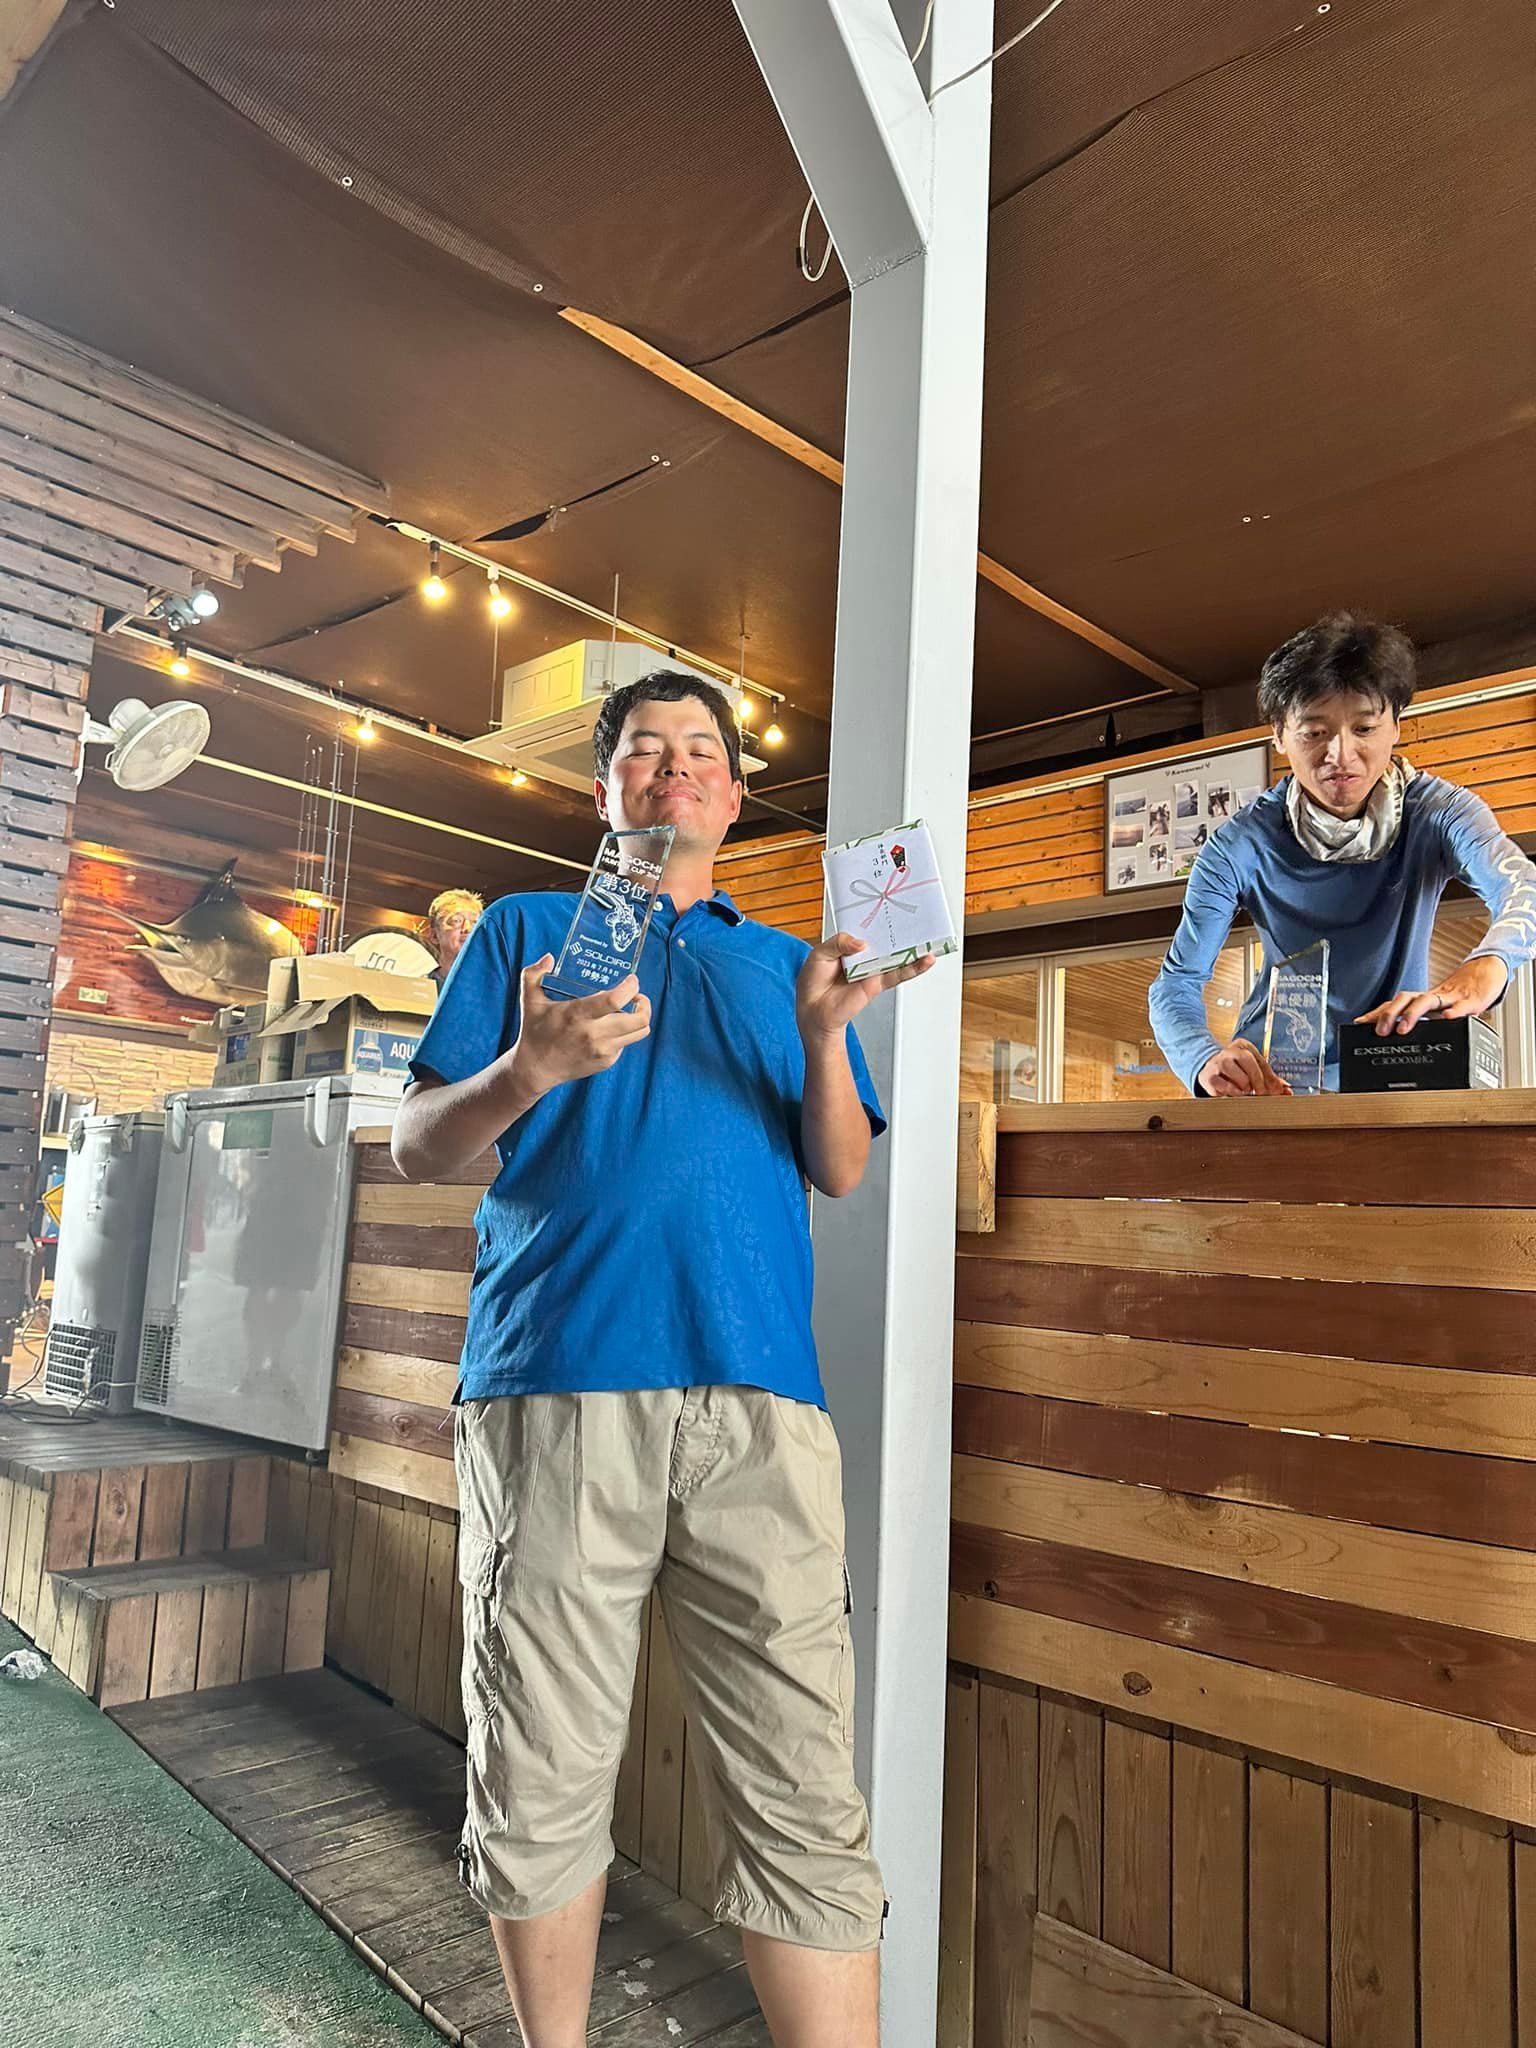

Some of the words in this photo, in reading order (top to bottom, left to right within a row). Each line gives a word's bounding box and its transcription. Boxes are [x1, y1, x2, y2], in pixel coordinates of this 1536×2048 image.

[604, 848, 662, 873] MAGOCHI
[631, 866, 646, 875] CUP
[601, 872, 649, 901] 第3位
[584, 948, 631, 970] SOLDIRO
[1354, 1045, 1420, 1056] EXSENCE
[1426, 1043, 1452, 1051] XR
